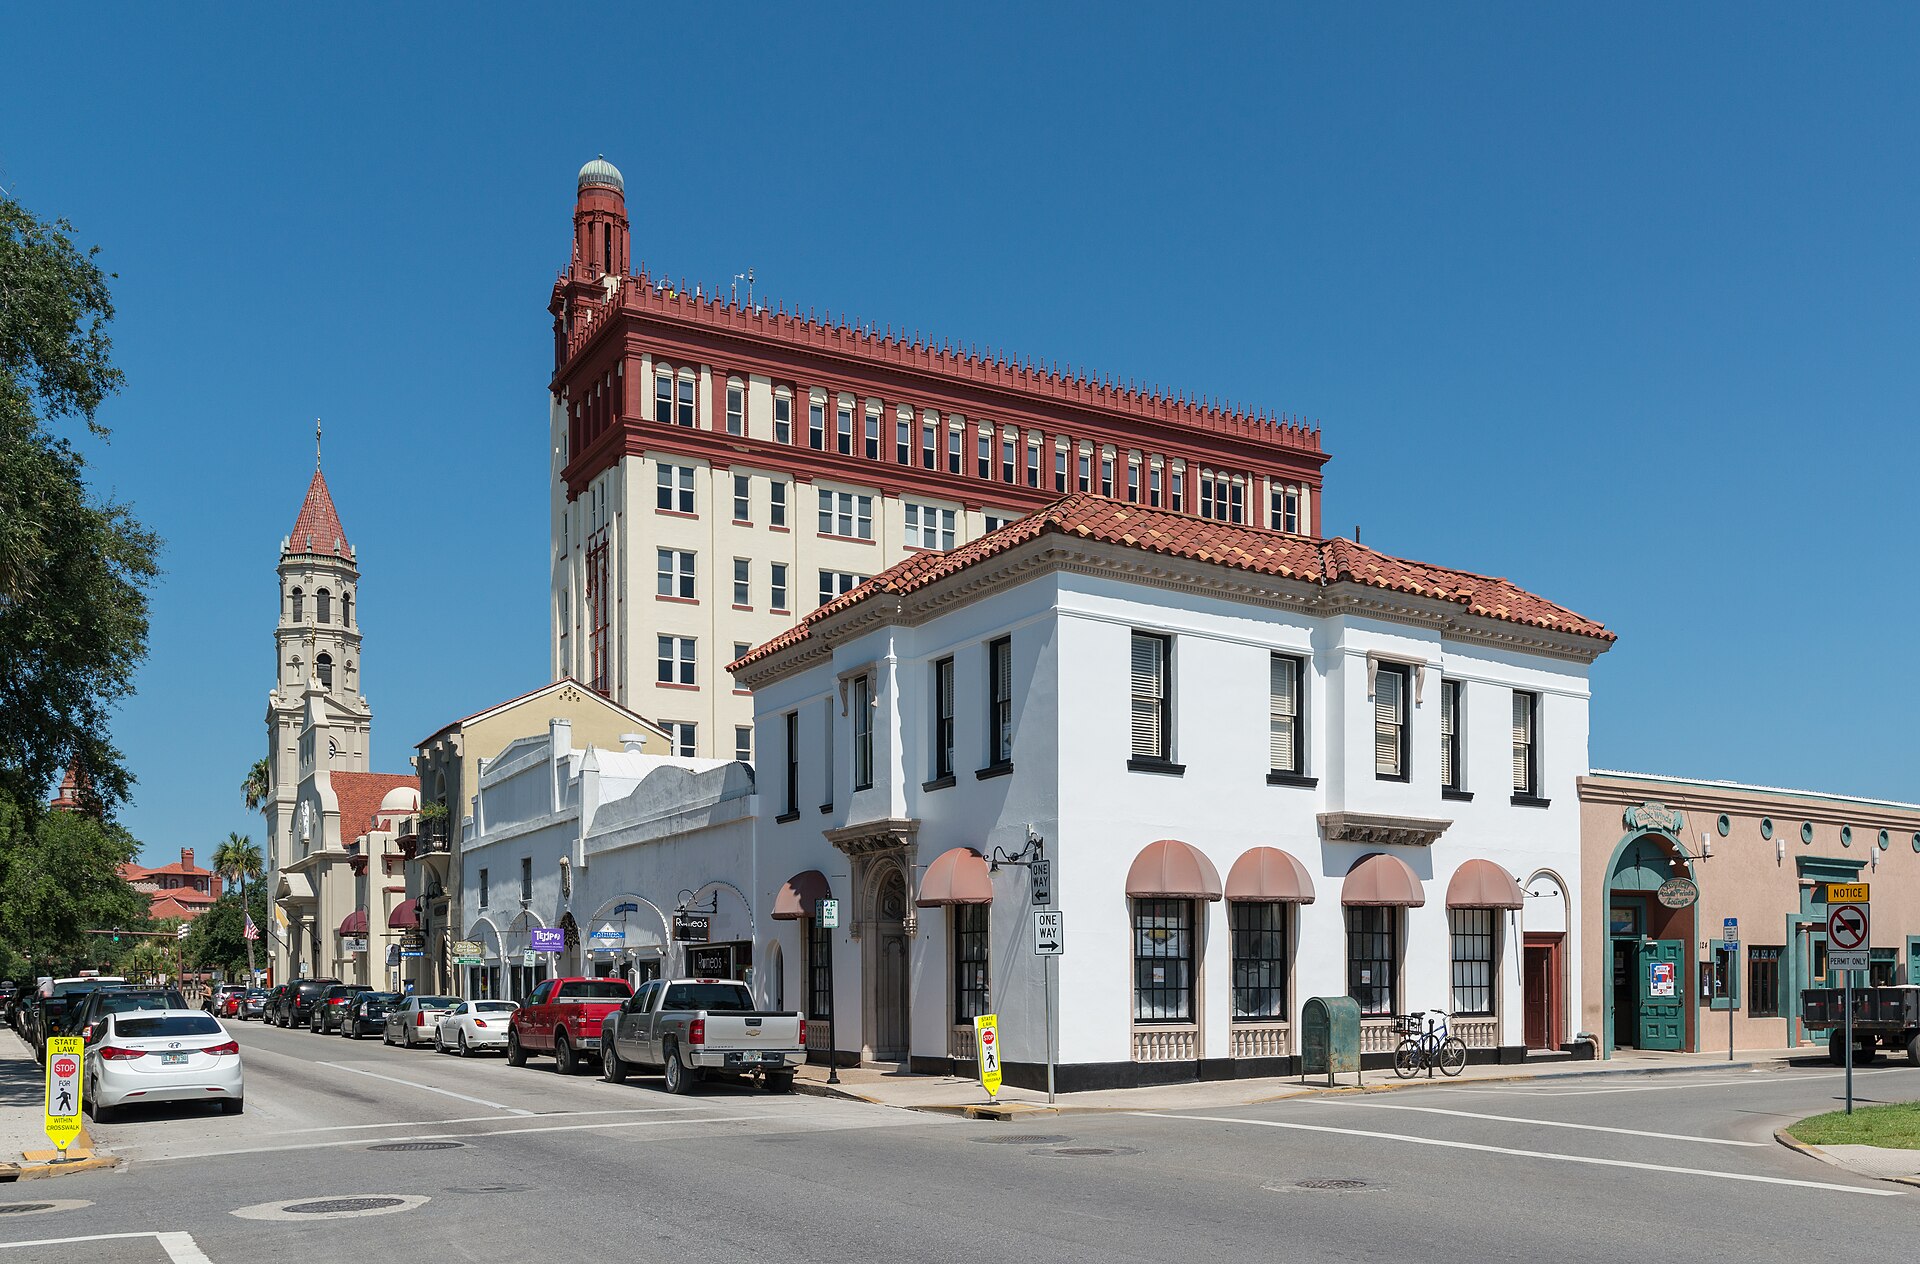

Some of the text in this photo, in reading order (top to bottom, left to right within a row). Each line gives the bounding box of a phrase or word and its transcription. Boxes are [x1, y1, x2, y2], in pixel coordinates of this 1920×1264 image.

[1033, 864, 1048, 875] ONE
[1033, 877, 1048, 887] WAY
[1833, 888, 1863, 898] NOTICE
[675, 917, 708, 928] Reo's
[1039, 915, 1057, 925] ONE
[1040, 928, 1057, 938] WAY
[55, 1064, 75, 1072] STOP
